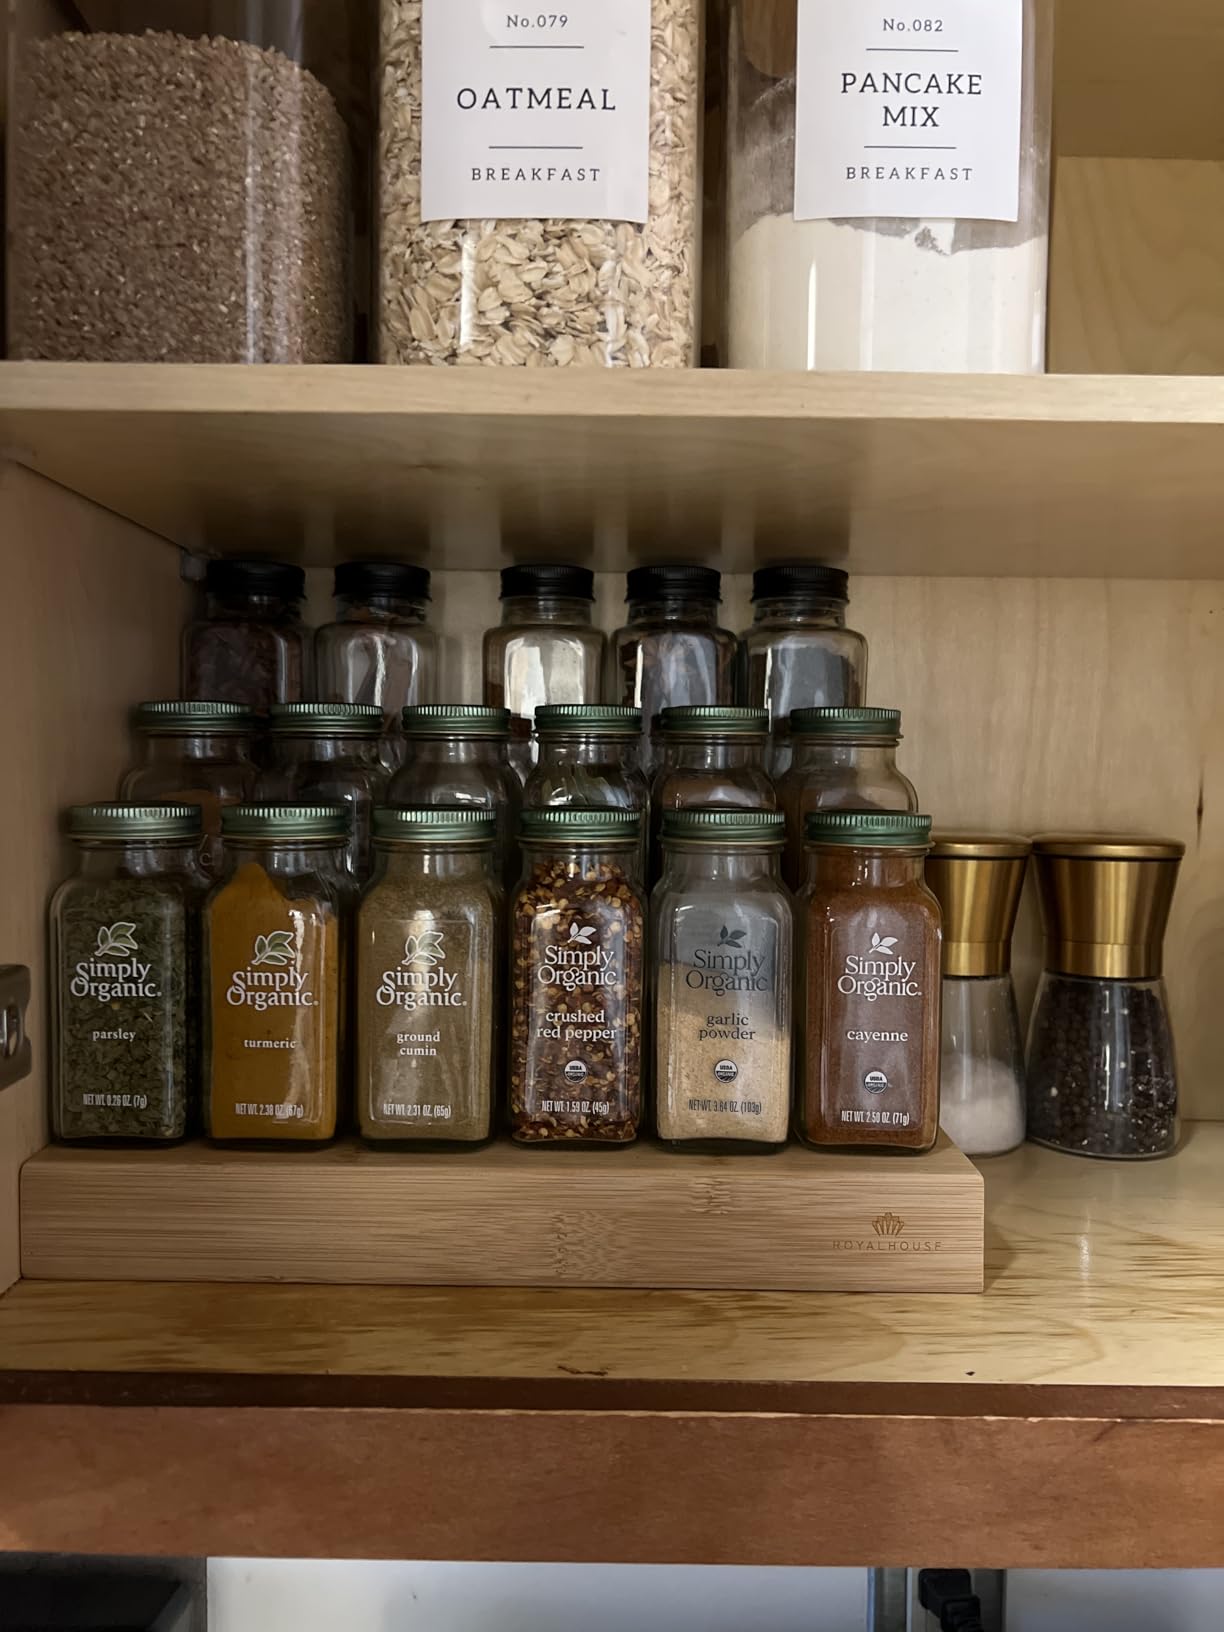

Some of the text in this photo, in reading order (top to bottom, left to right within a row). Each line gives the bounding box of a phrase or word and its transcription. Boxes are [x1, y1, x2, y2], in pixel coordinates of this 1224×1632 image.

[506, 14, 570, 29] No.079
[882, 17, 944, 33] No.082
[840, 72, 984, 96] PANCAKE
[456, 88, 617, 112] OATMEAL
[881, 105, 940, 128] MIX
[471, 166, 601, 182] BREAKFAST
[845, 166, 974, 181] BREAKFAST
[544, 945, 615, 971] Simply
[693, 949, 765, 977] Simply
[75, 957, 152, 984] Simply
[845, 956, 917, 982] Simply
[231, 966, 309, 992] Simply
[382, 966, 458, 993] Simply
[545, 1009, 605, 1024] crushed
[706, 1012, 749, 1028] garlic
[92, 1027, 137, 1043] parsley
[396, 1031, 441, 1044] ground
[536, 1026, 617, 1042] red pepper
[698, 1026, 756, 1041] powder
[847, 1029, 909, 1043] cayenne
[244, 1037, 298, 1050] turmeric
[399, 1045, 437, 1056] cumin
[83, 1093, 94, 1105] NET
[688, 1099, 700, 1111] NET
[235, 1103, 246, 1115] NET
[383, 1103, 394, 1115] NET
[541, 1100, 553, 1112] NET
[566, 1101, 581, 1113] 1.59
[592, 1101, 610, 1116] (45g)
[841, 1110, 853, 1122] NET
[866, 1111, 880, 1124] 2.50
[892, 1111, 910, 1127] (71g)
[832, 1240, 944, 1252] ROYALHOUSE
